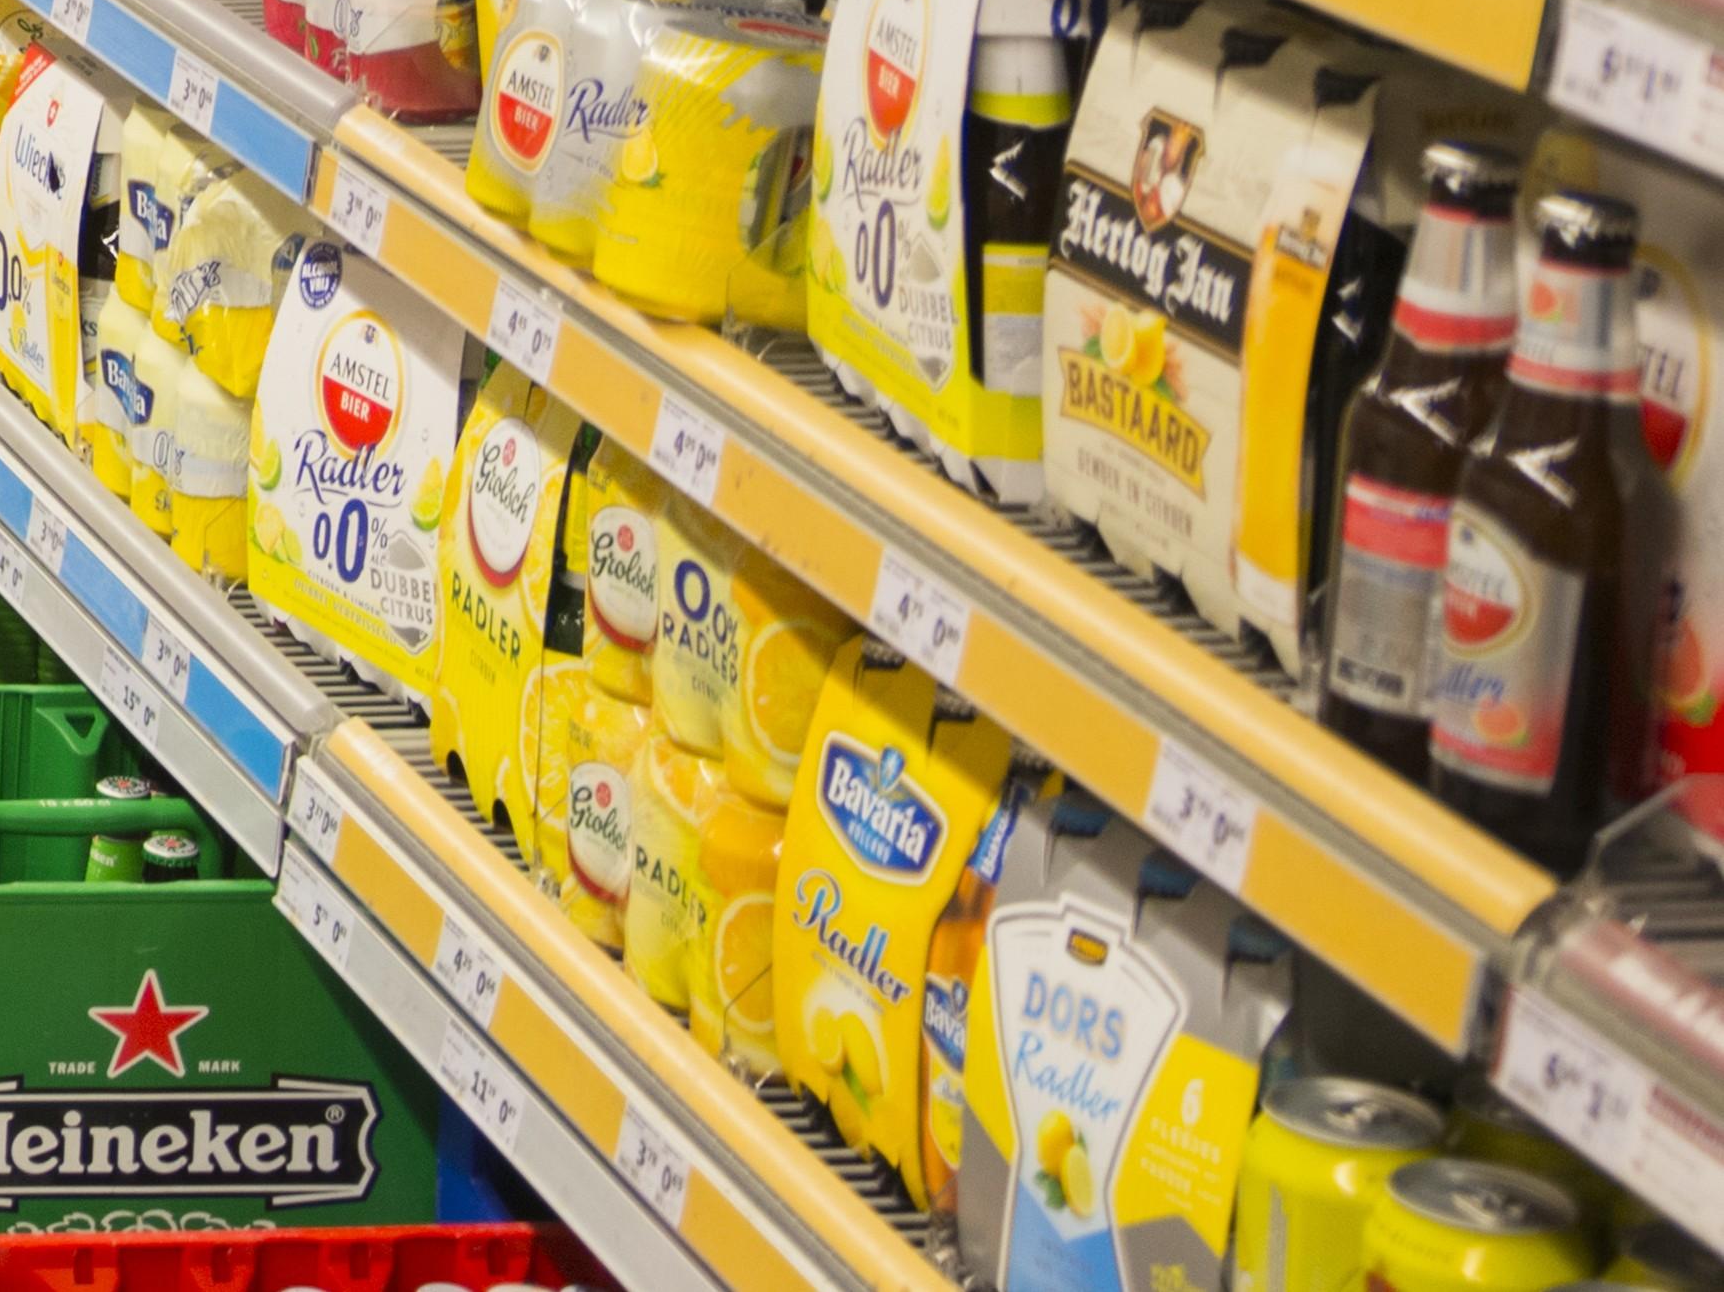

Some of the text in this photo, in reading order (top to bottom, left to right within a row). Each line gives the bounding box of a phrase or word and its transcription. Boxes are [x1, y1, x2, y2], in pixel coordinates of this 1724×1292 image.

[871, 15, 921, 69] AMSTEL
[842, 116, 924, 195] Radler
[1062, 182, 1236, 324] Hertog Jan
[332, 351, 389, 401] AMSTEL
[341, 392, 370, 422] BIER
[1066, 353, 1204, 468] BASTAARD
[294, 429, 406, 504] Radler
[475, 440, 536, 525] Grolsch
[590, 530, 655, 609] Grolsch
[380, 596, 432, 625] CITRUS
[452, 571, 520, 667] RADLER
[661, 609, 739, 688] RADLER
[826, 761, 931, 871] Bavaria
[793, 866, 910, 1008] Radler
[1020, 971, 1128, 1057] DORS
[48, 1062, 95, 1074] TRADE
[198, 1060, 240, 1073] MARK
[1015, 1034, 1122, 1126] Radler
